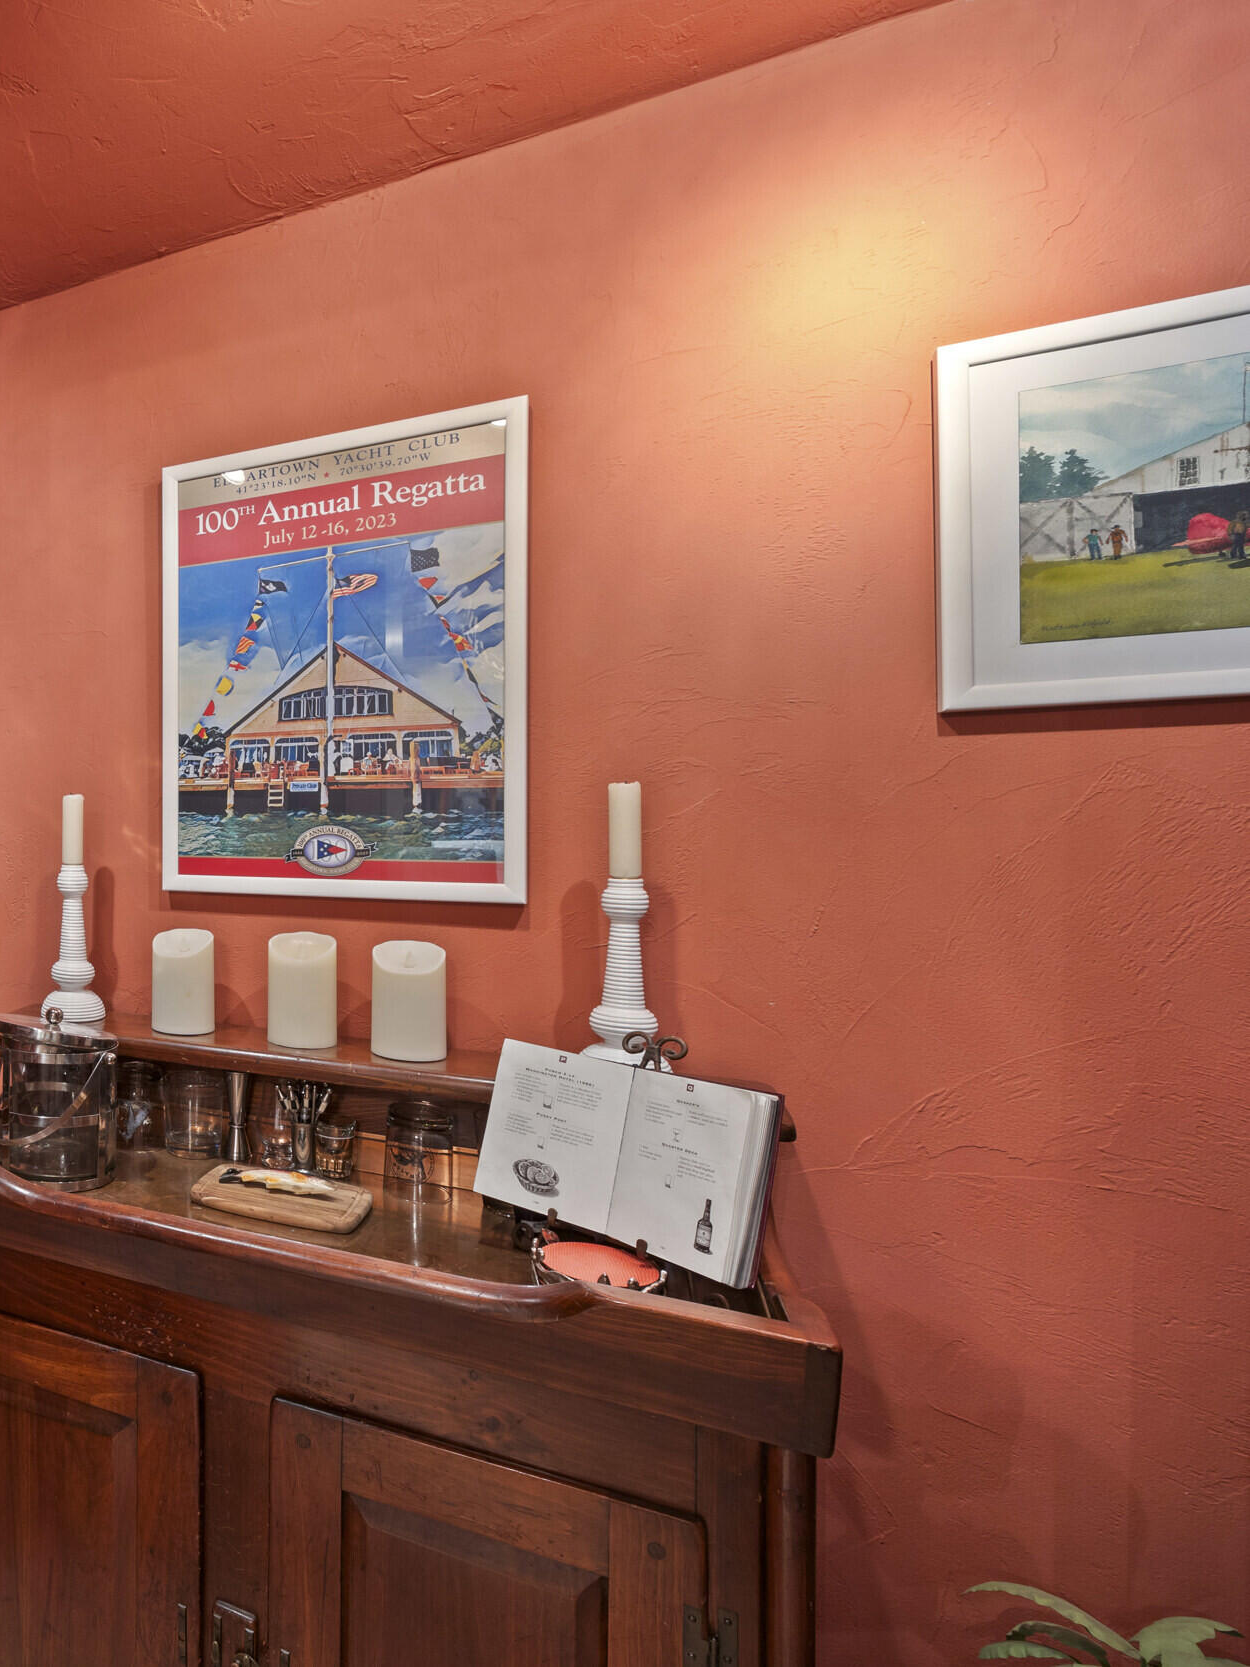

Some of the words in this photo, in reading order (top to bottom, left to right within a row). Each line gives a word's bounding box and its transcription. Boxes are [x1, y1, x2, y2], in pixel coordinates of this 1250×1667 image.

[333, 444, 396, 466] YACHT
[408, 432, 461, 452] CLUB
[257, 484, 362, 526] Annual
[370, 472, 487, 508] Regatta
[263, 528, 295, 549] July
[355, 512, 397, 532] 2023
